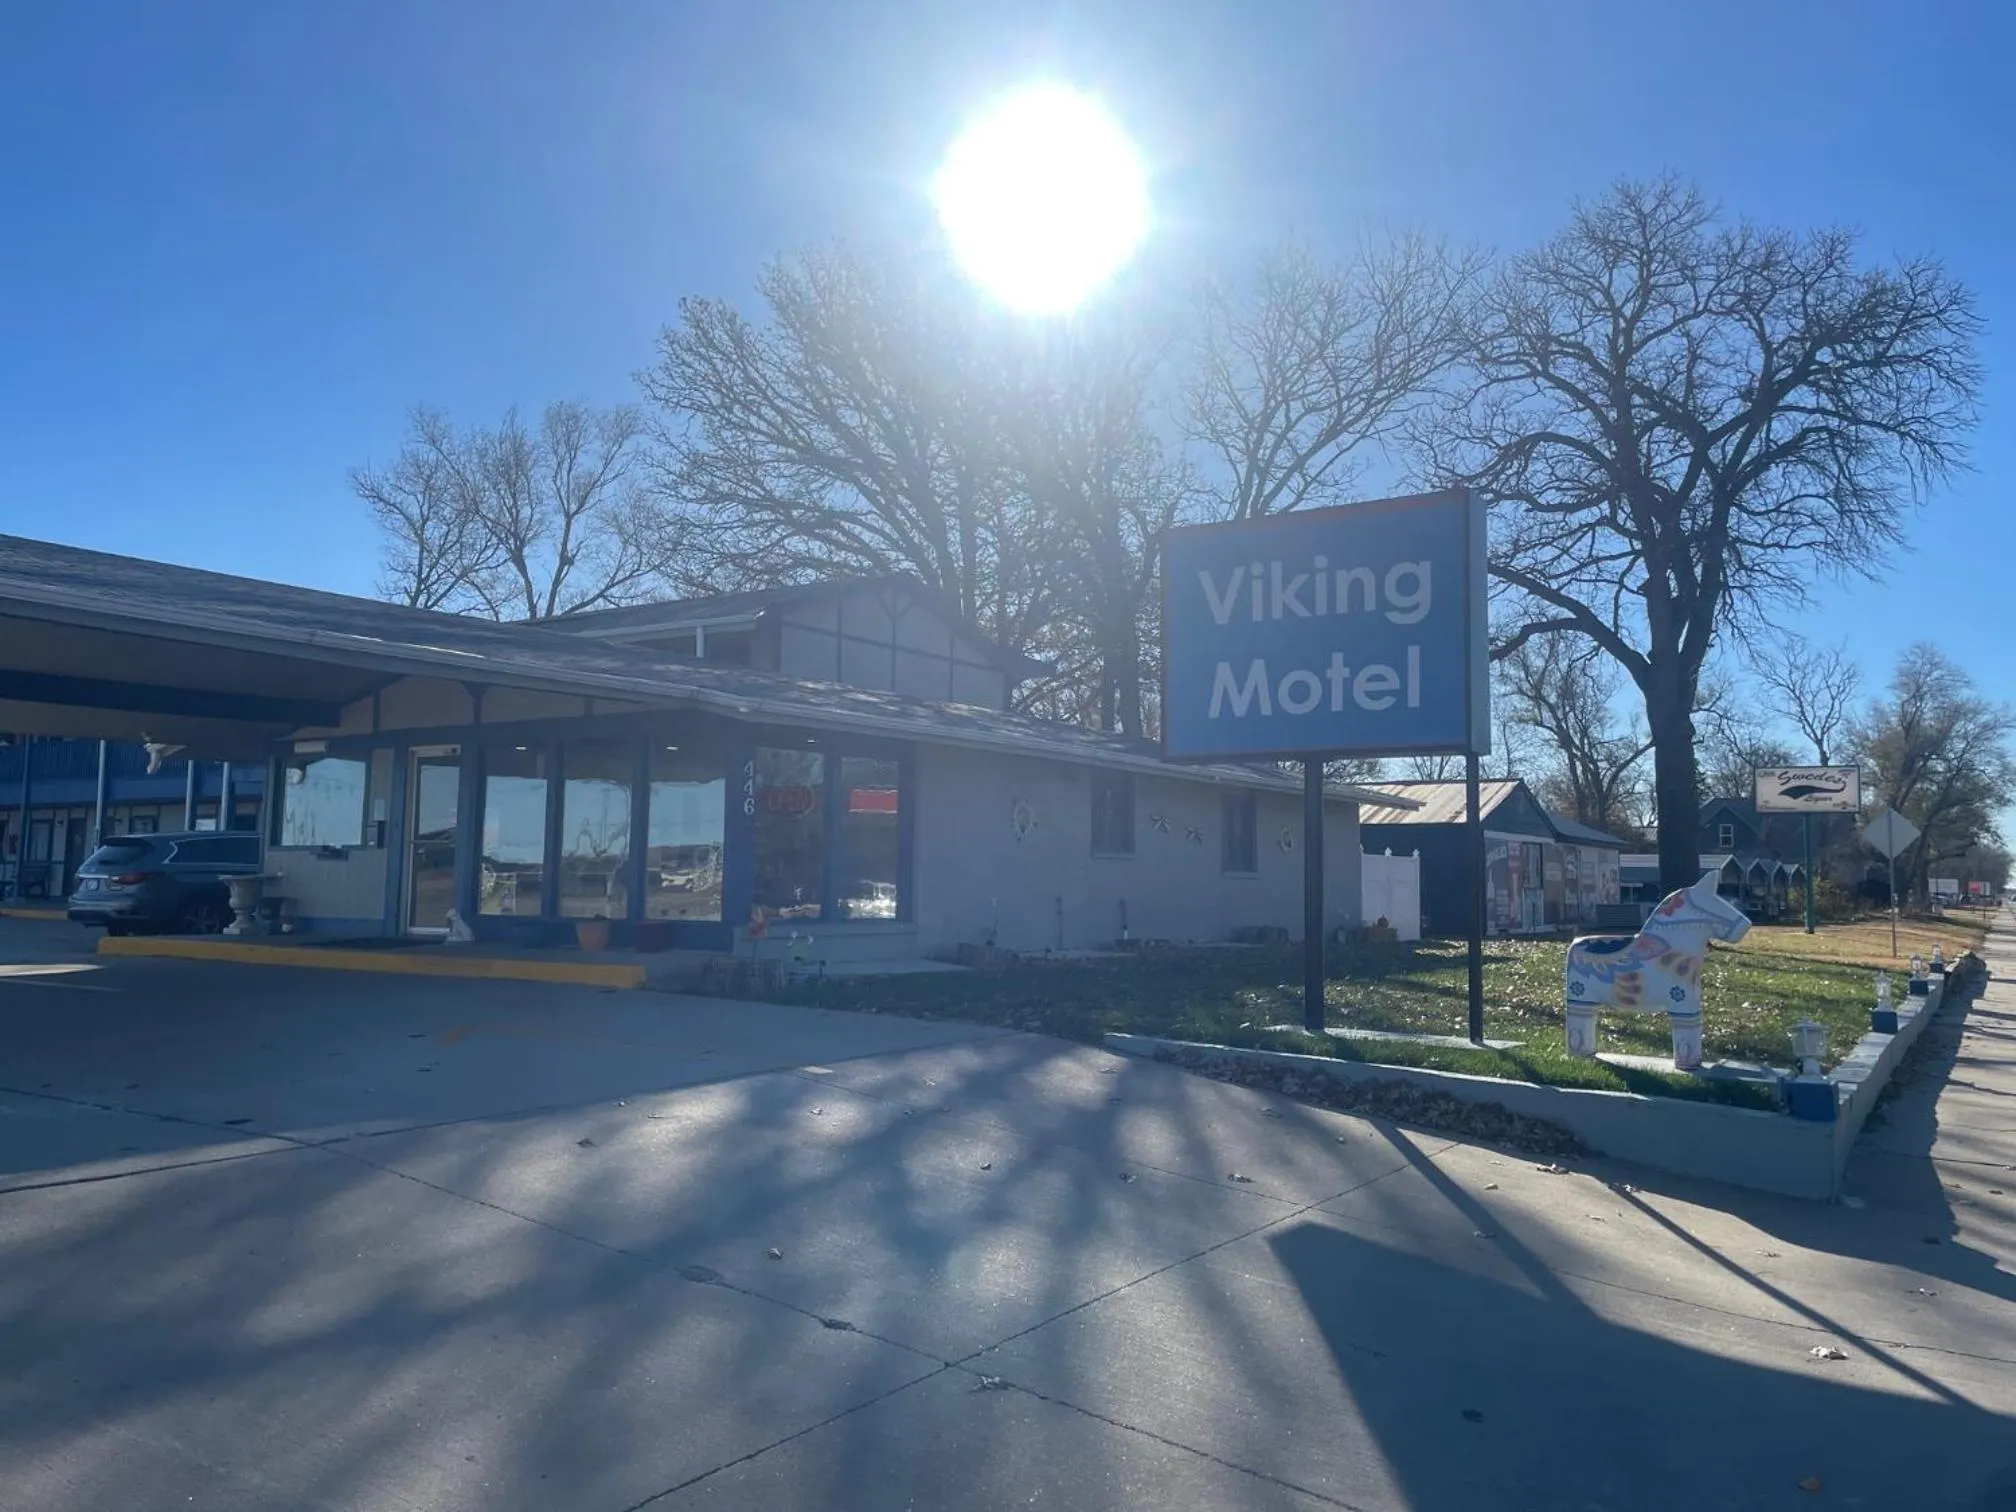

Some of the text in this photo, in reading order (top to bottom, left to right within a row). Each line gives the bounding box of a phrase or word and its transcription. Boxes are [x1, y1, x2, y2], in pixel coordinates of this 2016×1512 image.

[1198, 555, 1432, 625] Viking
[1208, 645, 1421, 719] Motel
[743, 760, 756, 816] 446
